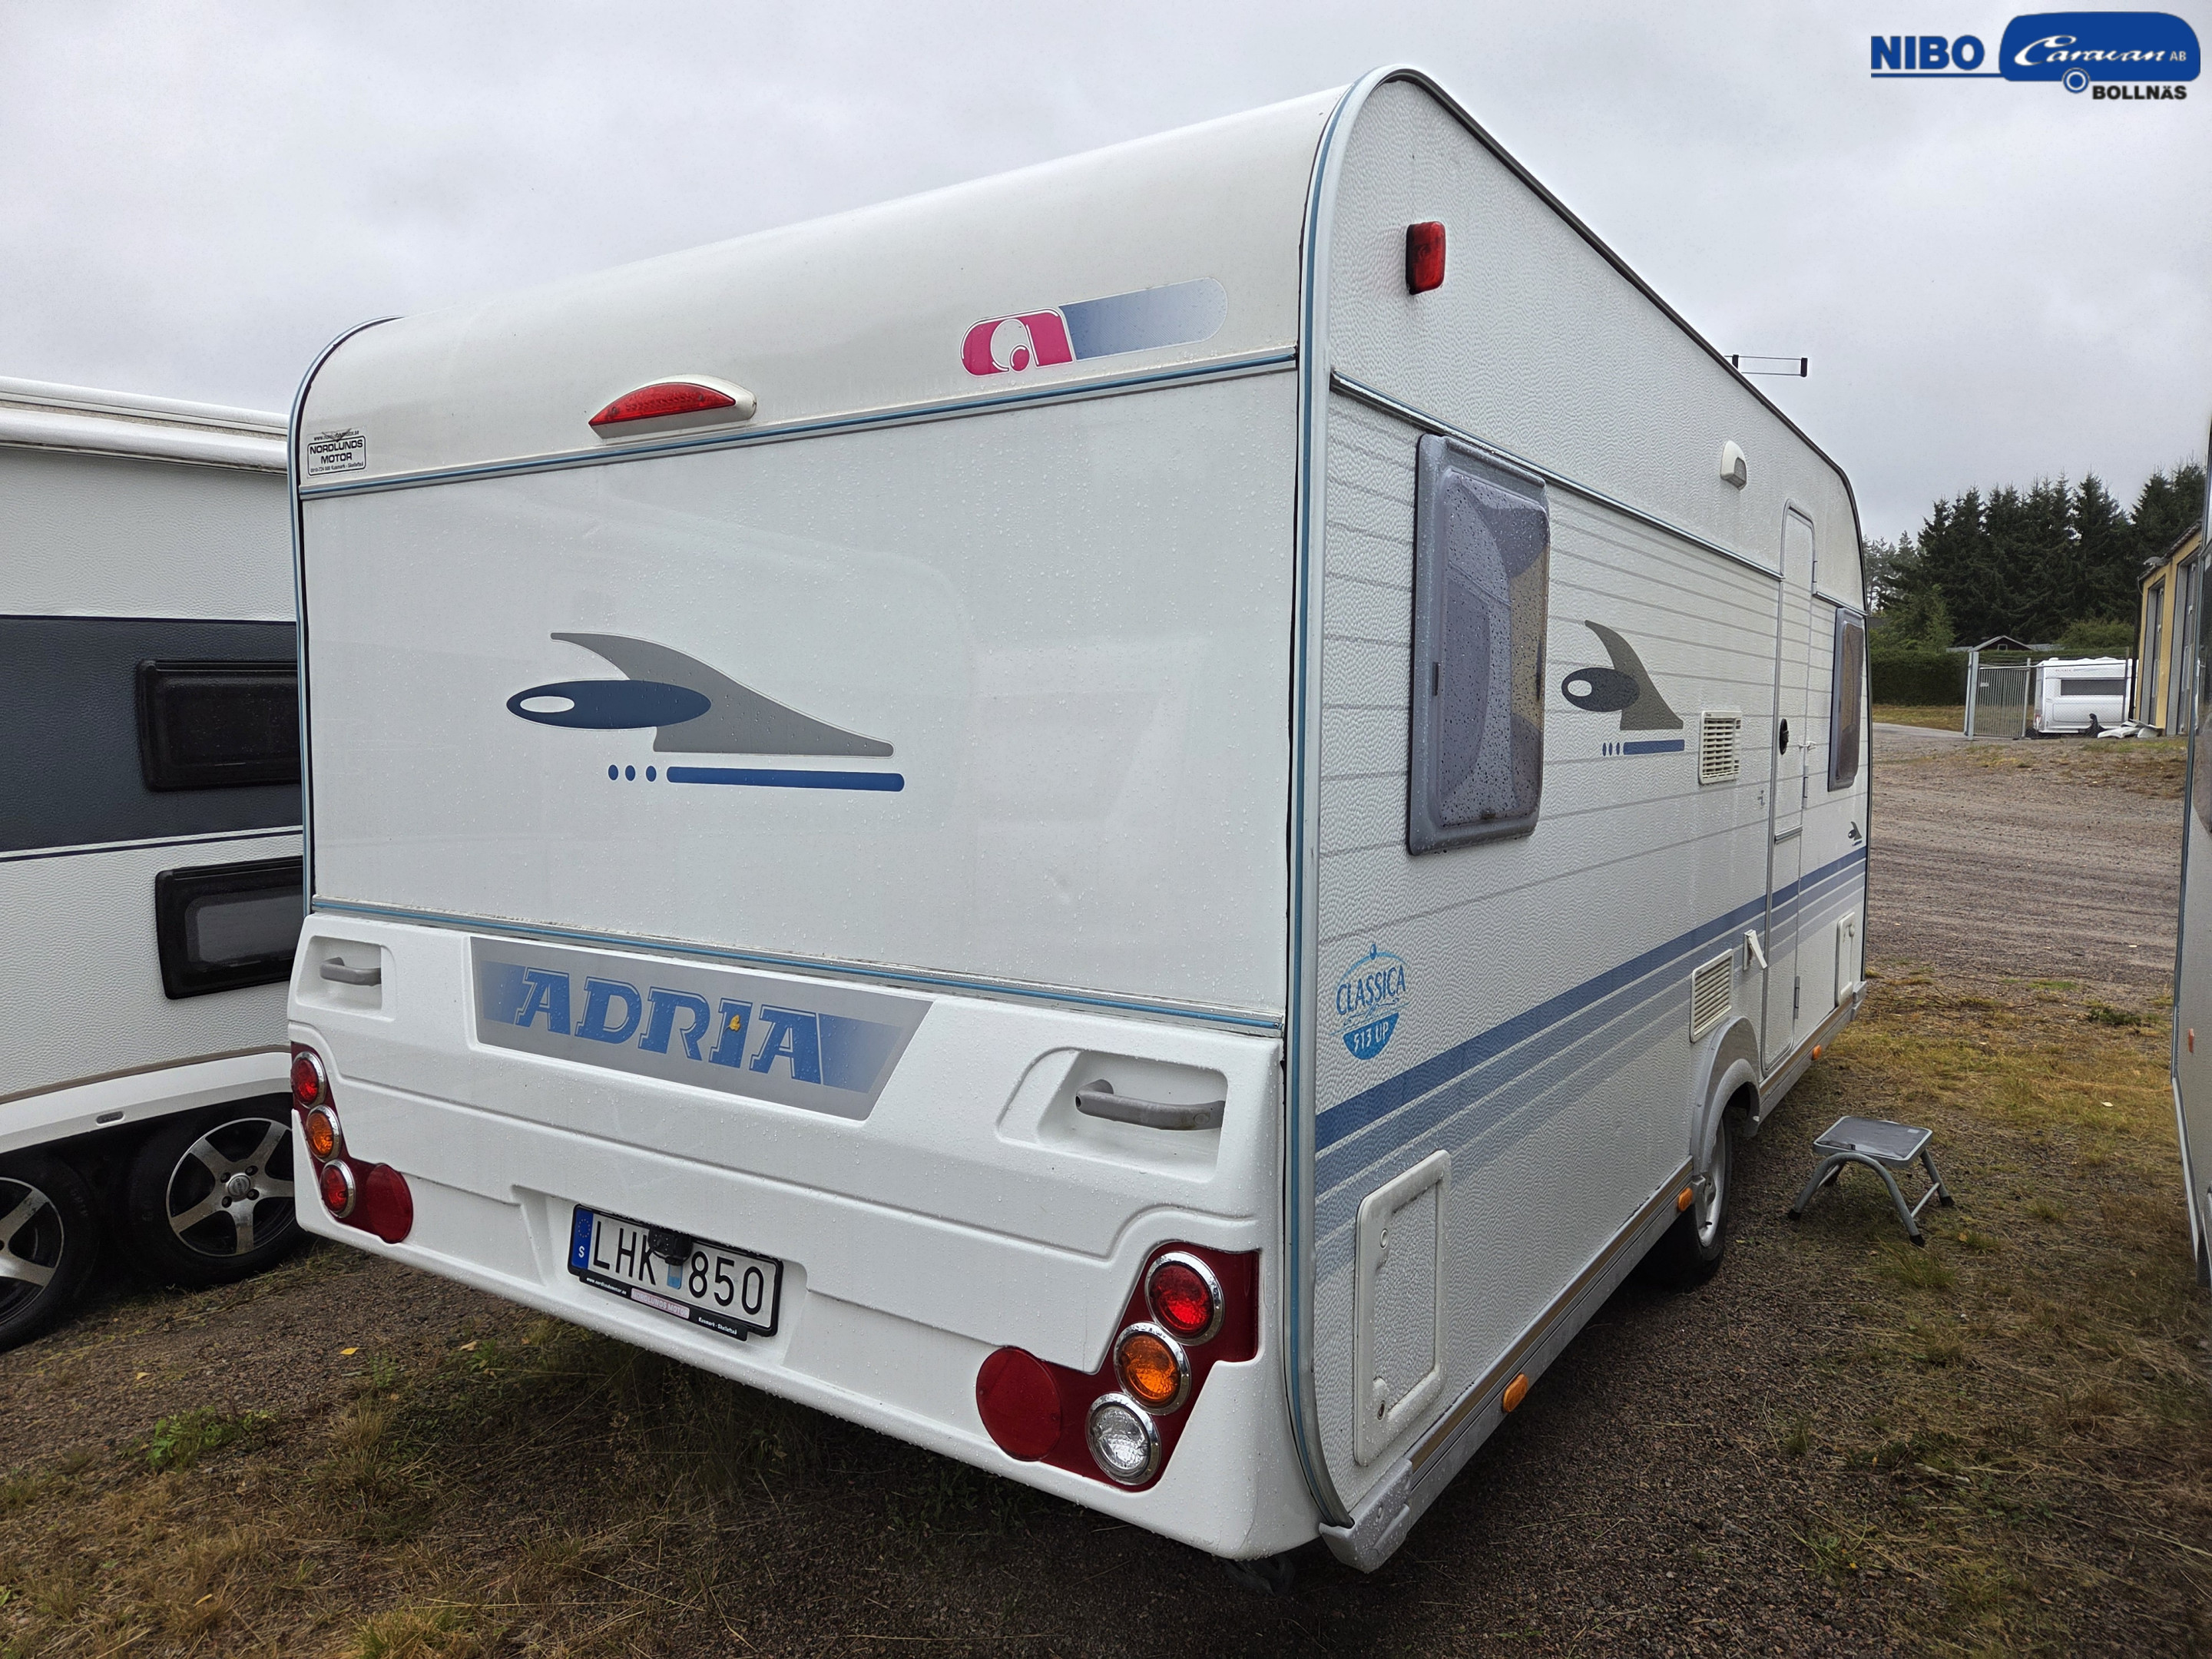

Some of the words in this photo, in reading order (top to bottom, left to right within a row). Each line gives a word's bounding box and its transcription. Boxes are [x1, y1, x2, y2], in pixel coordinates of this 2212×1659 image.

[310, 439, 363, 455] NORDLUNDS
[320, 452, 353, 465] MOTOR
[1336, 965, 1406, 1015] CLASSICA
[515, 968, 823, 1085] ADRIA
[1375, 1022, 1389, 1044] UP
[578, 1245, 585, 1258] S
[593, 1220, 656, 1285] LHK
[688, 1250, 764, 1315] 850
[632, 1290, 667, 1309] NORDLUNDS
[667, 1303, 688, 1316] MOTOR
